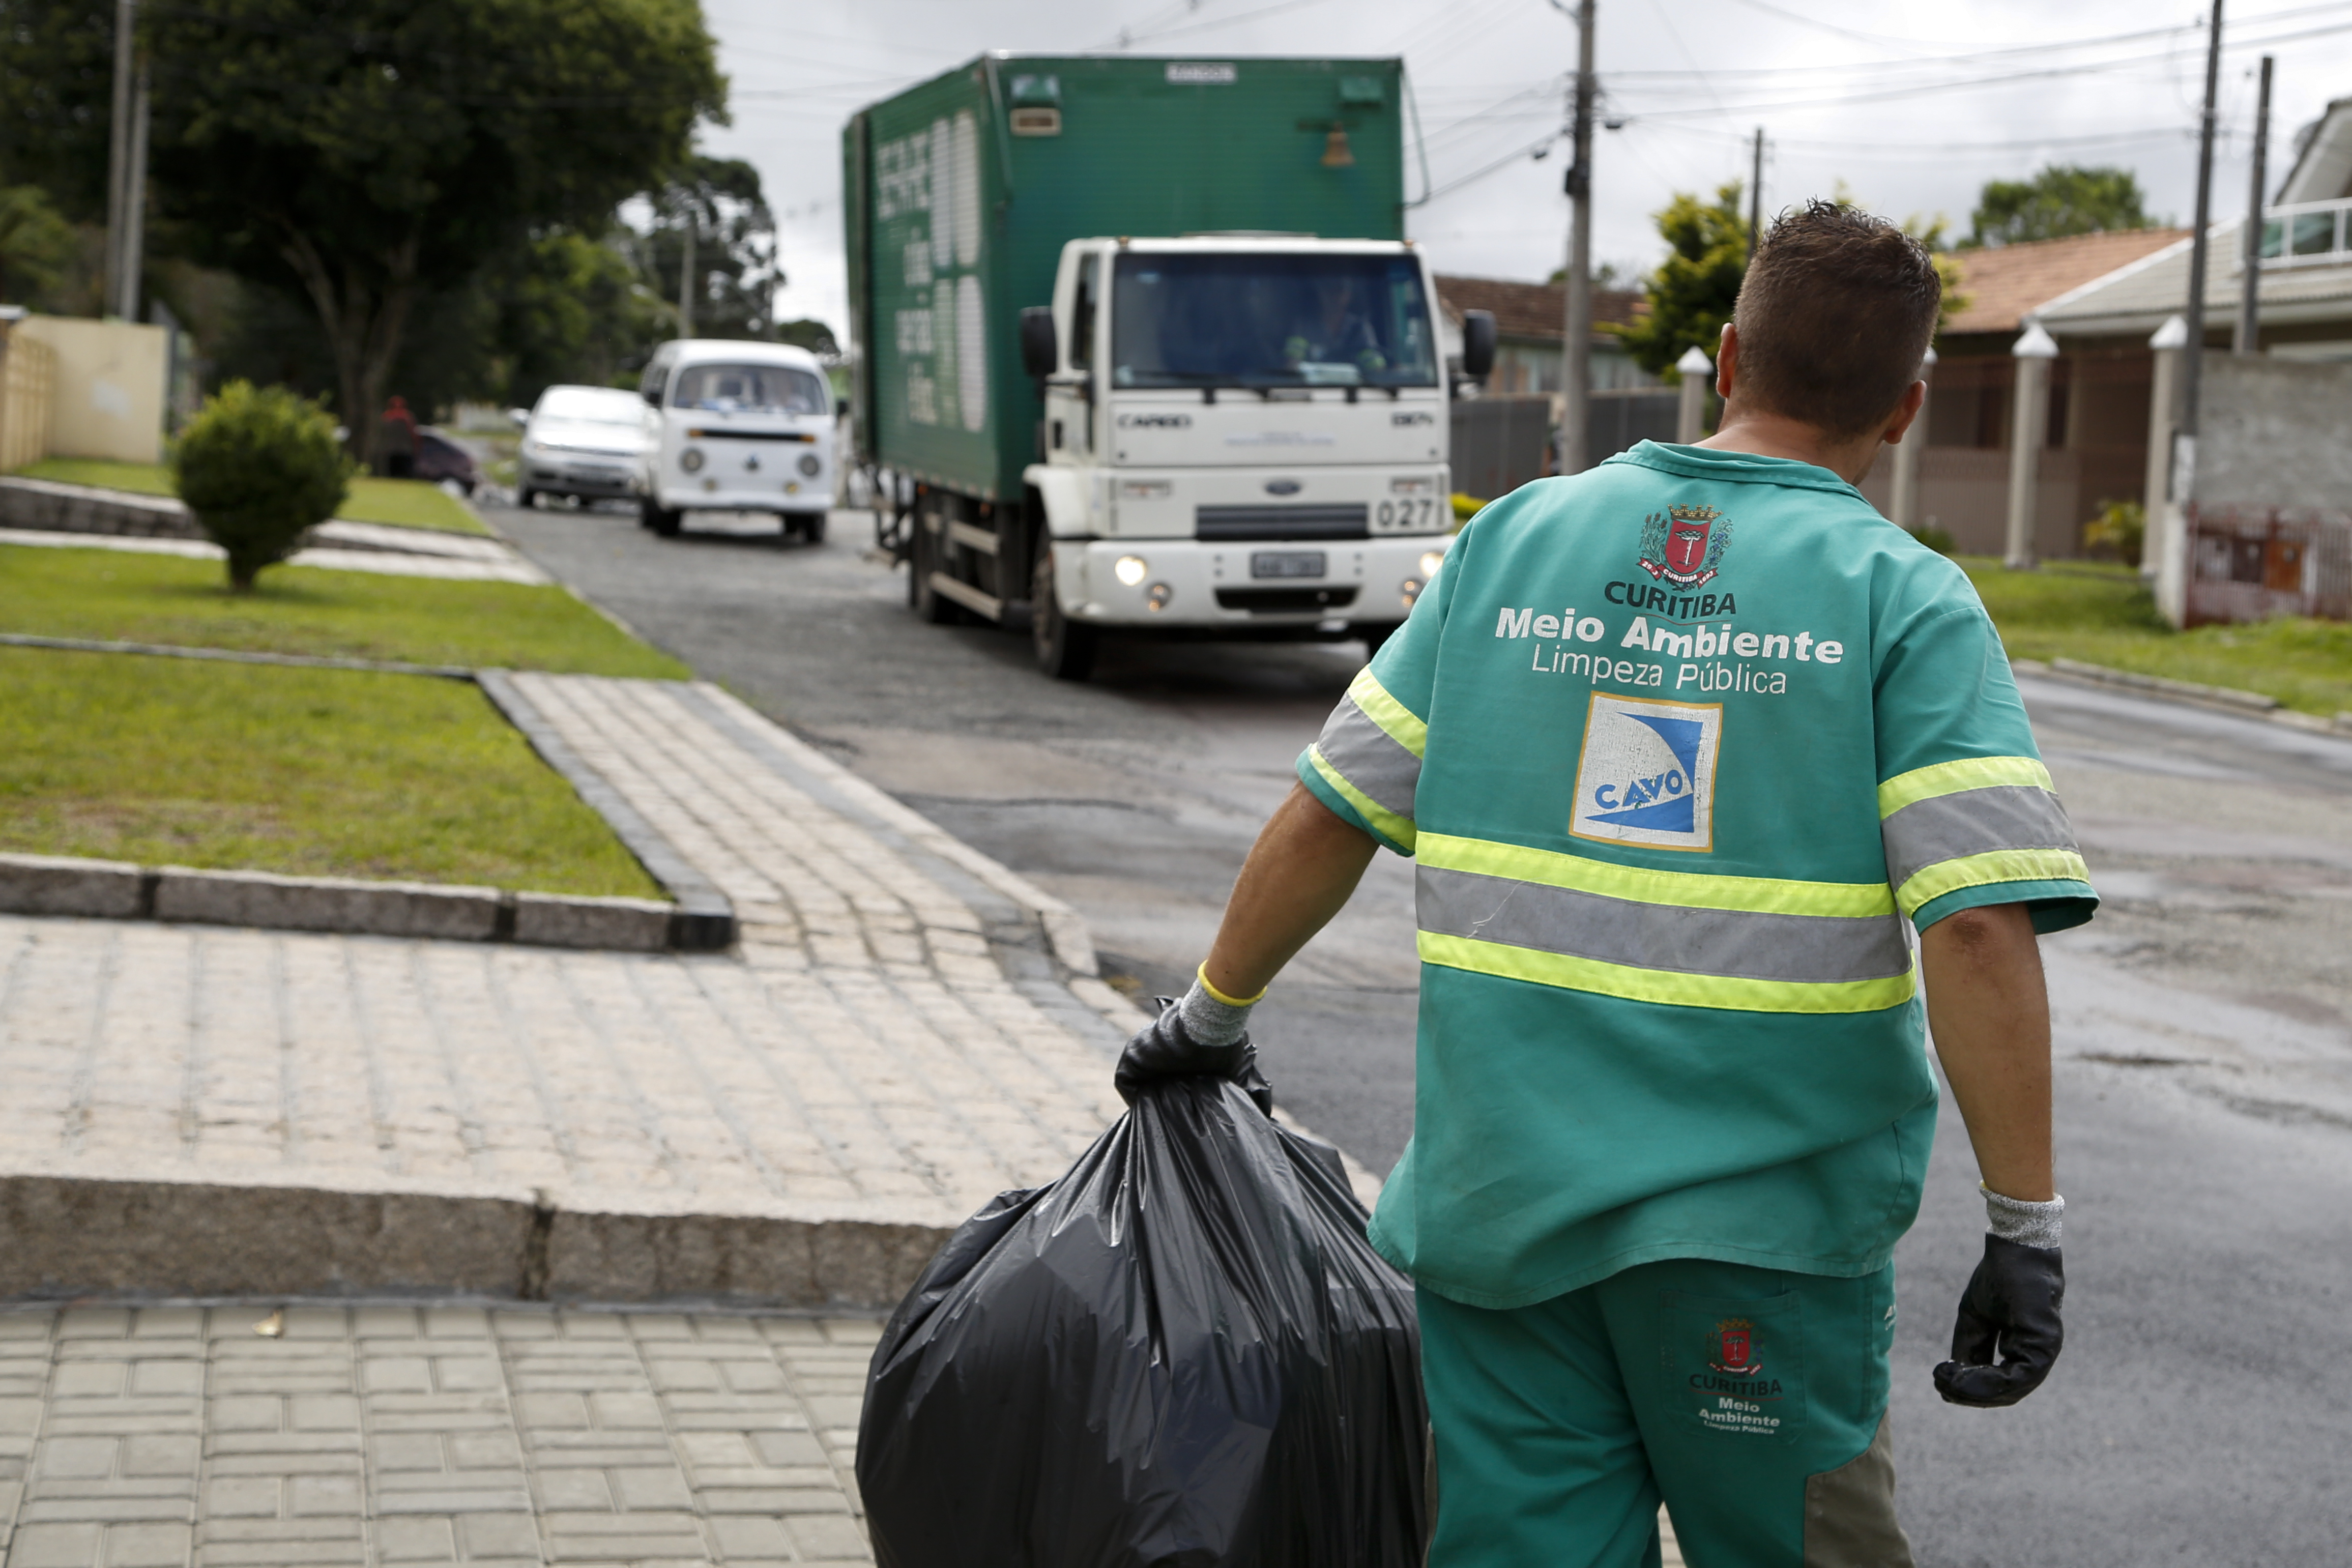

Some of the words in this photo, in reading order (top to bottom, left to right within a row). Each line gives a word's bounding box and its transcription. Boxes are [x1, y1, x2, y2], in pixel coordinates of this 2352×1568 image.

[1663, 569, 1697, 582] CURITIBA
[1604, 580, 1736, 619] CURITIBA
[1495, 607, 1605, 642] Meio
[1621, 616, 1844, 664] Ambiente
[1532, 644, 1662, 686] Limpeza
[1676, 662, 1787, 694] Pública
[1595, 769, 1683, 809] CAVO
[1689, 1374, 1782, 1396] CURITIBA
[1719, 1397, 1760, 1413] Meio
[1698, 1408, 1781, 1427] Ambiente
[1704, 1420, 1740, 1431] Limpeza
